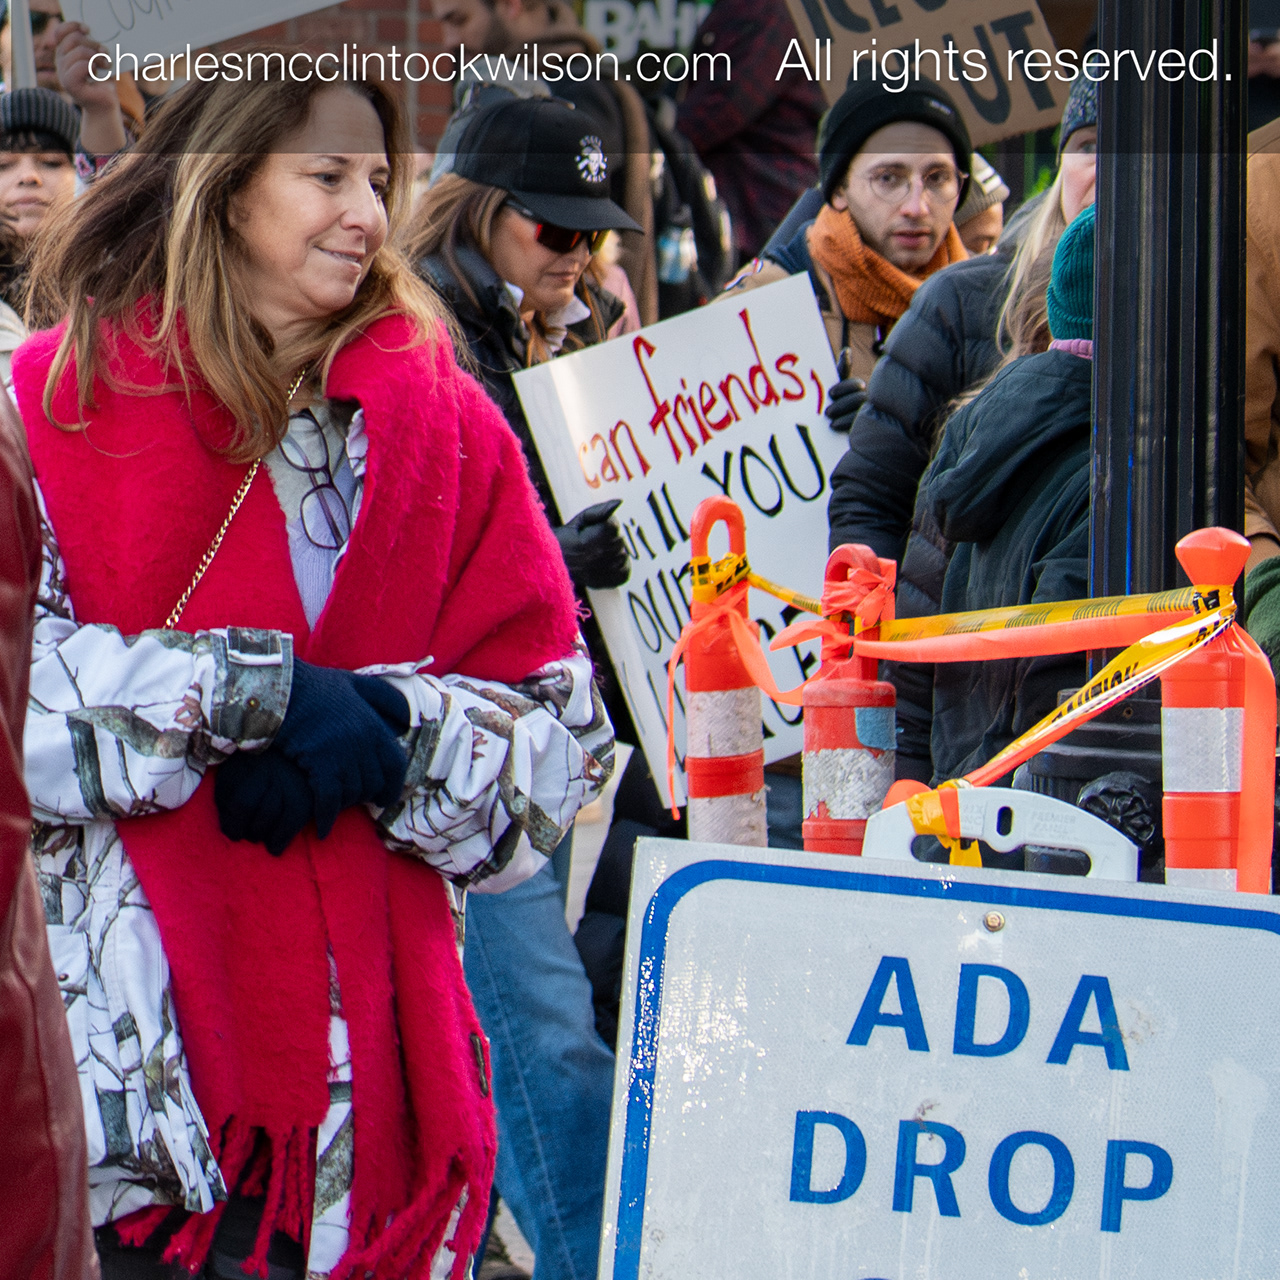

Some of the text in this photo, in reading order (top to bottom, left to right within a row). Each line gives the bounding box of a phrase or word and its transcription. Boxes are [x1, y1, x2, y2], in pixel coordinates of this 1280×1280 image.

[577, 307, 826, 490] can friends,
[700, 422, 826, 518] YOU
[845, 955, 1131, 1072] ADA
[788, 1109, 1175, 1234] DROP
